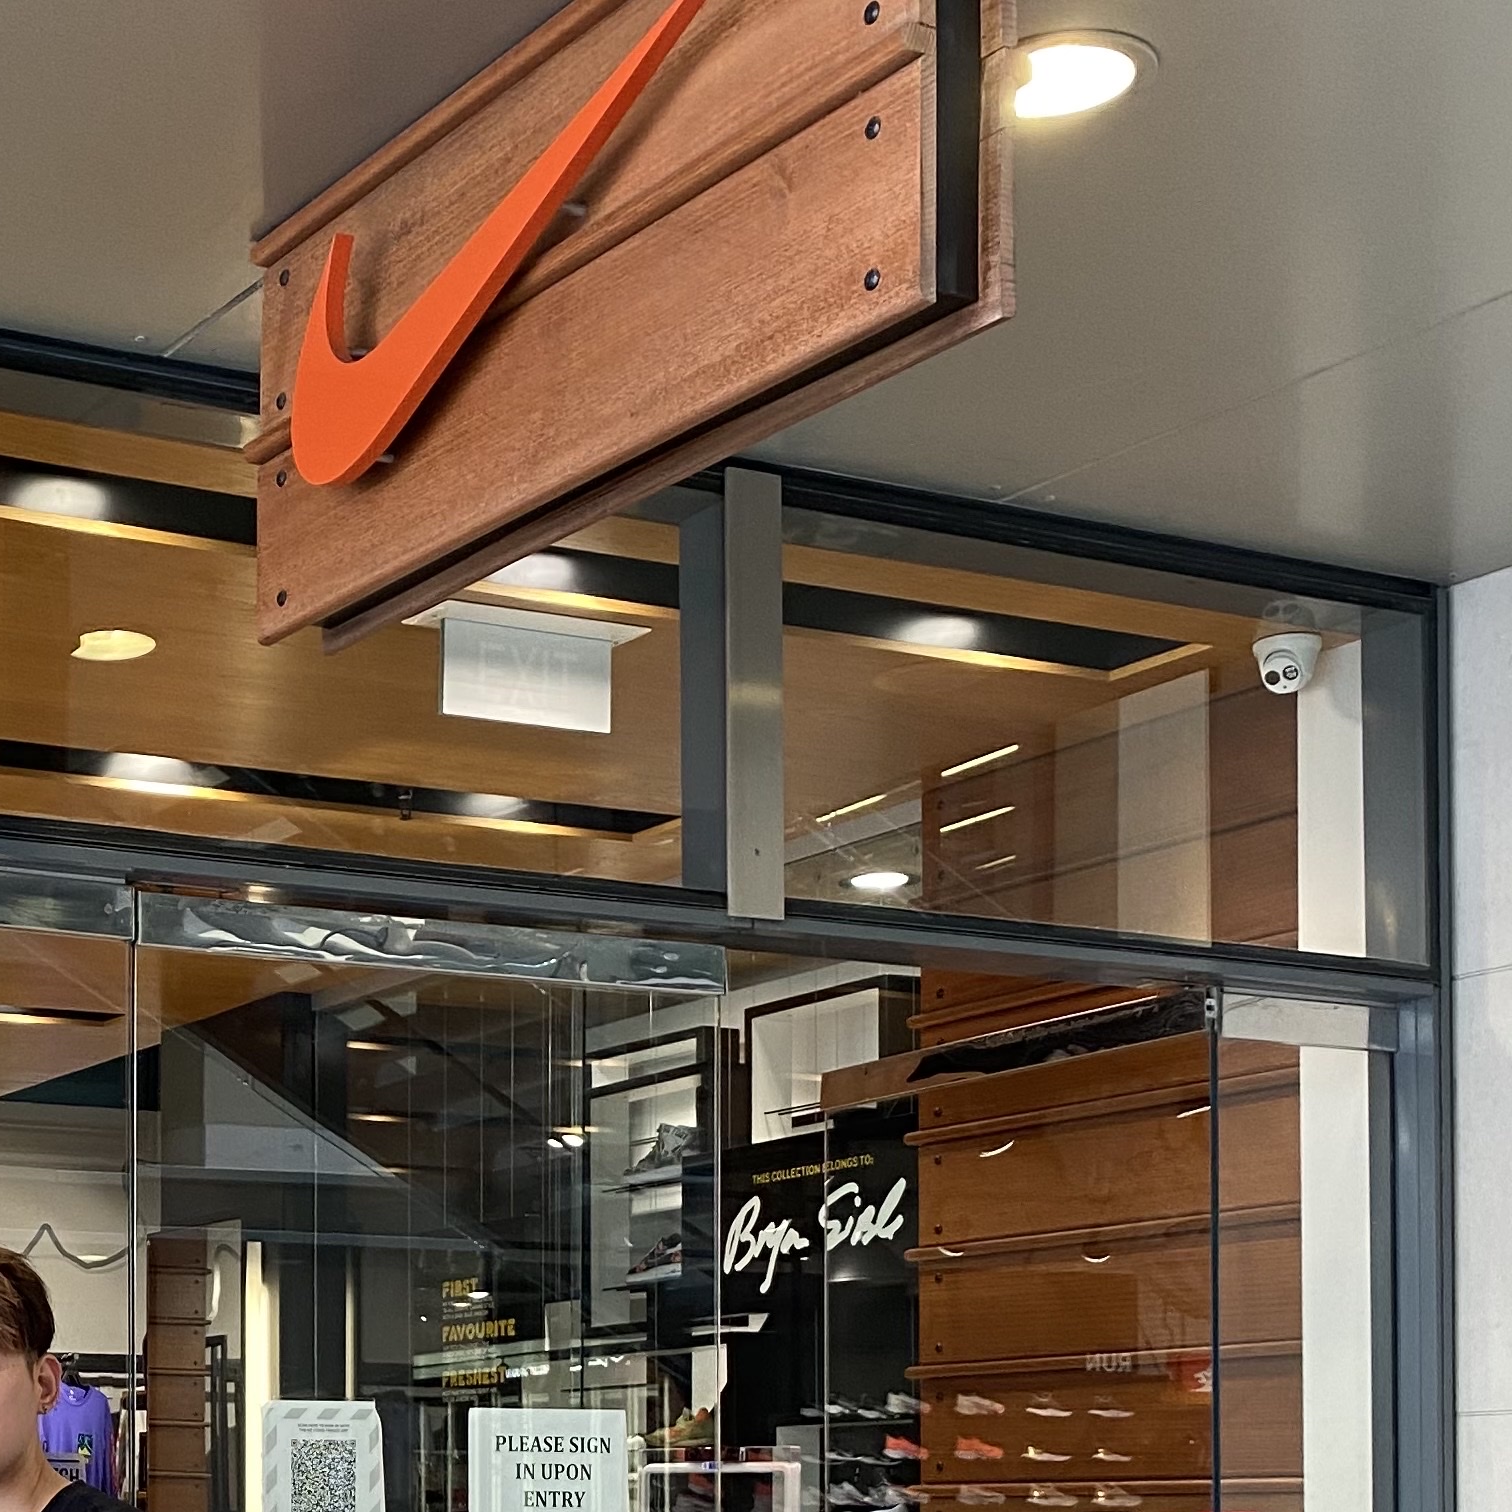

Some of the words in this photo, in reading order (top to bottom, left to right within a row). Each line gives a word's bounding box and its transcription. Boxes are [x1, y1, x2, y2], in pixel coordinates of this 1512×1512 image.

[752, 1173, 771, 1185] THIS
[771, 1163, 821, 1182] COLLECTION
[822, 1156, 858, 1173] BELONGS
[442, 1277, 479, 1299] FIRST
[442, 1318, 516, 1342] FAVOURITE
[442, 1366, 506, 1389] FRESHEST
[495, 1435, 565, 1453] PLEASE
[569, 1436, 611, 1454] SIGN
[515, 1463, 536, 1480] IN
[541, 1463, 592, 1481] UPON
[524, 1490, 586, 1508] ENTRY
